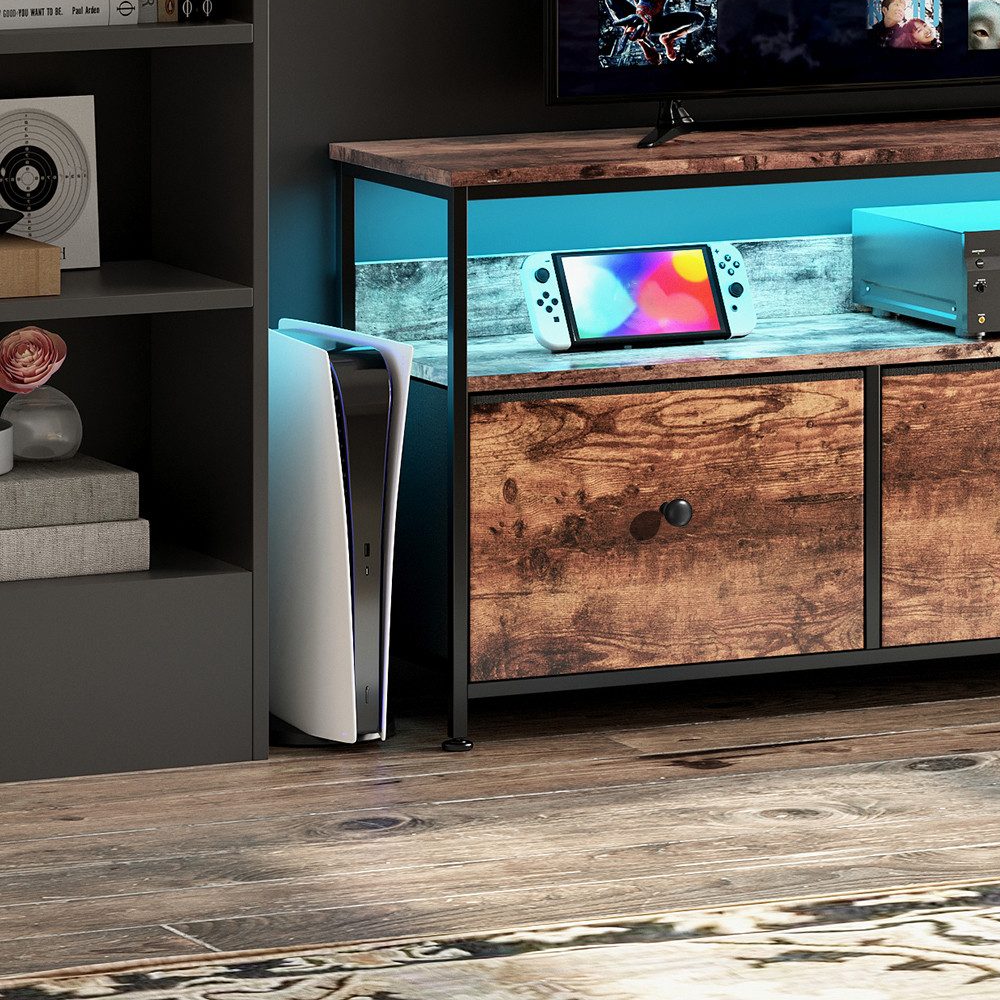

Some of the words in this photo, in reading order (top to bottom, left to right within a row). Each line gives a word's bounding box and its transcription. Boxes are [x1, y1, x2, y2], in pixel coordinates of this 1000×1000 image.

[30, 7, 45, 16] WANT
[47, 7, 53, 16] TO
[72, 6, 84, 15] Paul
[85, 5, 100, 14] Arden
